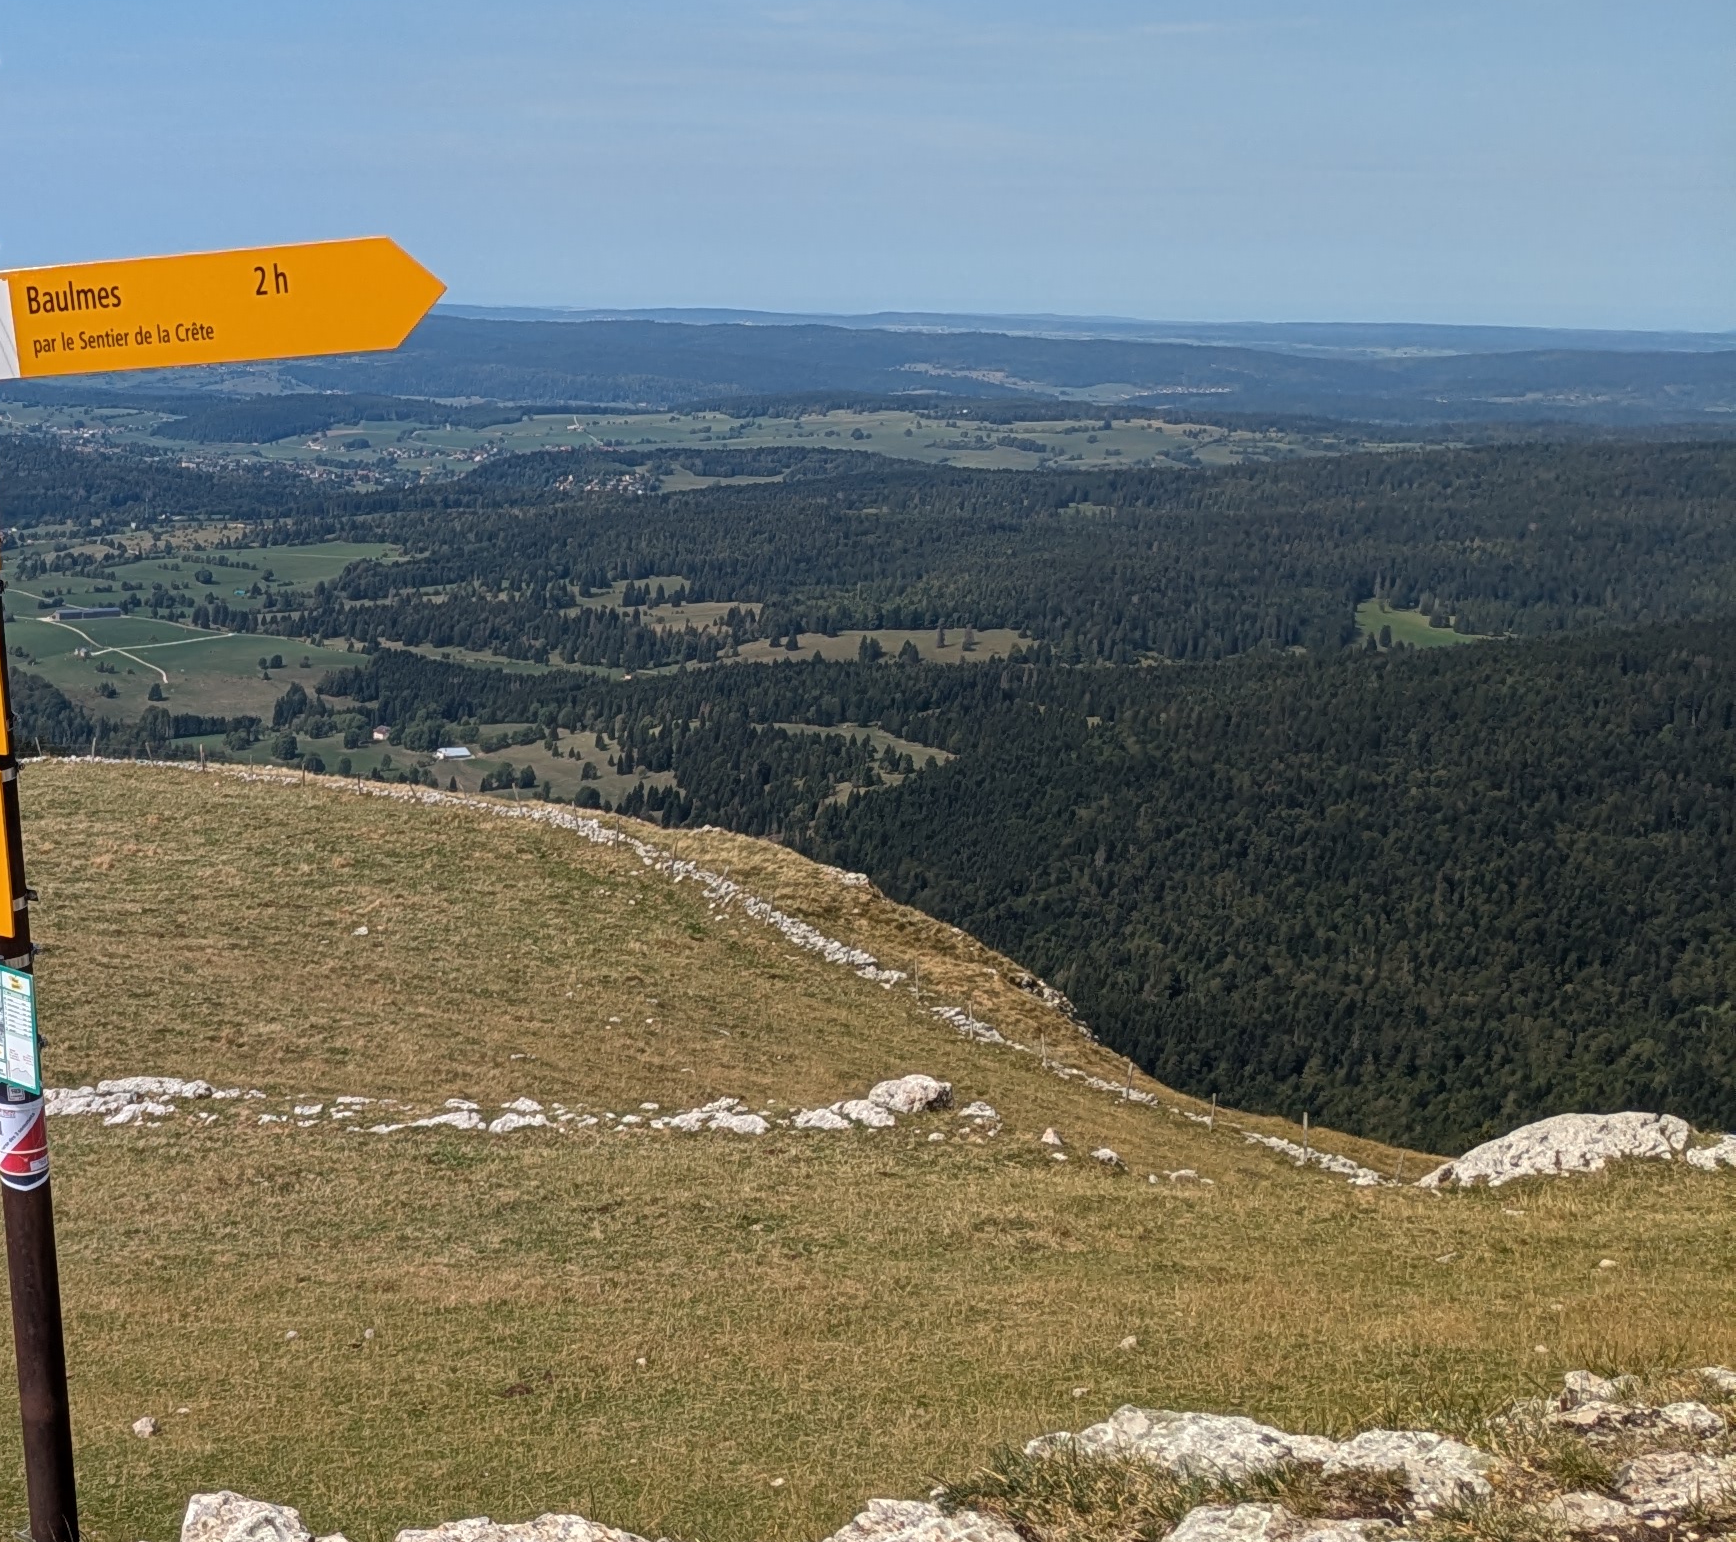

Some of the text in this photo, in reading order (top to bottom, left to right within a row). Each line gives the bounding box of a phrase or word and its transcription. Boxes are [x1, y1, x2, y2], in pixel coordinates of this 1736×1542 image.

[26, 263, 288, 314] Baulmes 2 h
[33, 322, 214, 358] par le Sentier de la Crête
